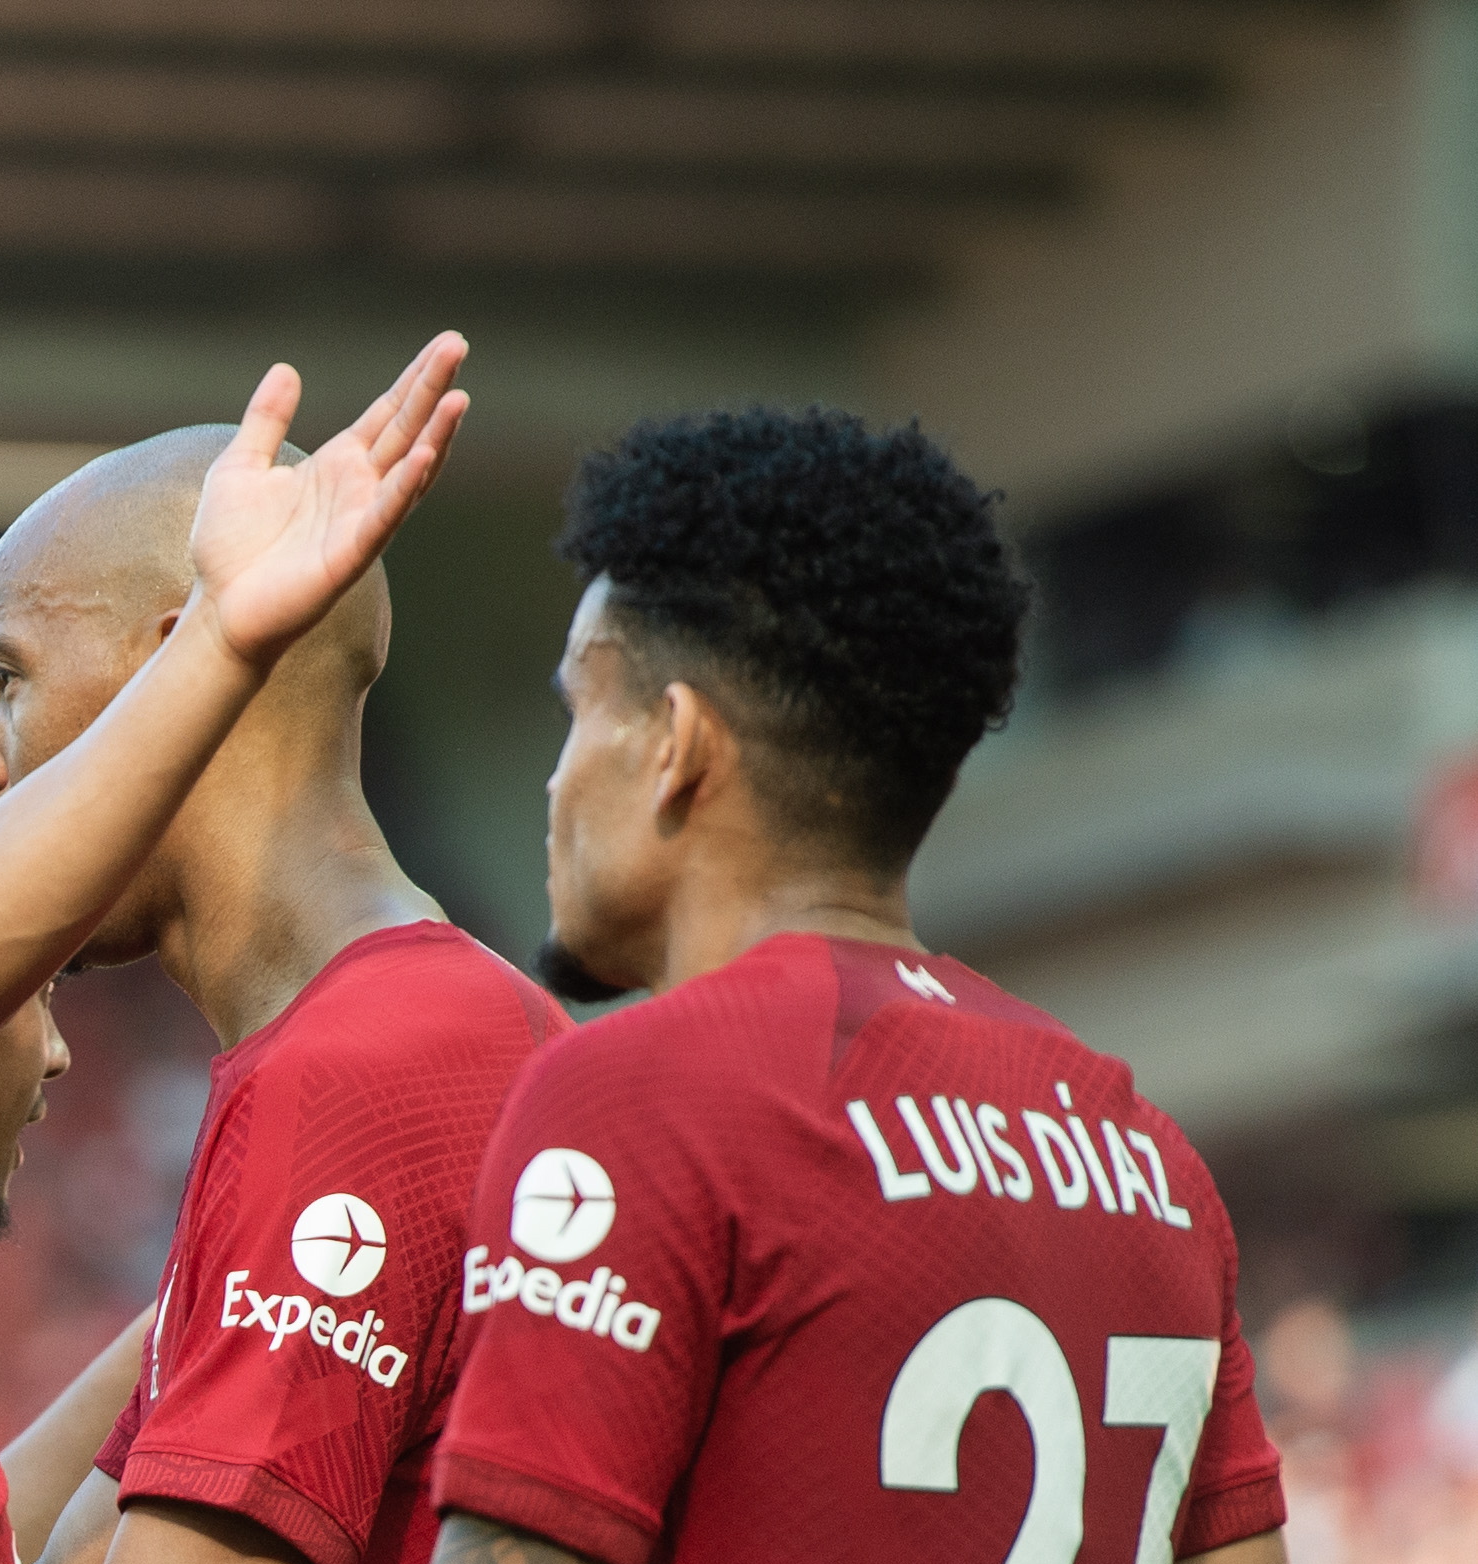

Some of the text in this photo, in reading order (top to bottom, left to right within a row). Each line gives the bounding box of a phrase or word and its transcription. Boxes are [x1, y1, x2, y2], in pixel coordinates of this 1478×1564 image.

[847, 1082, 1193, 1230] LUIS DÍAZ
[220, 1269, 409, 1388] Expedia
